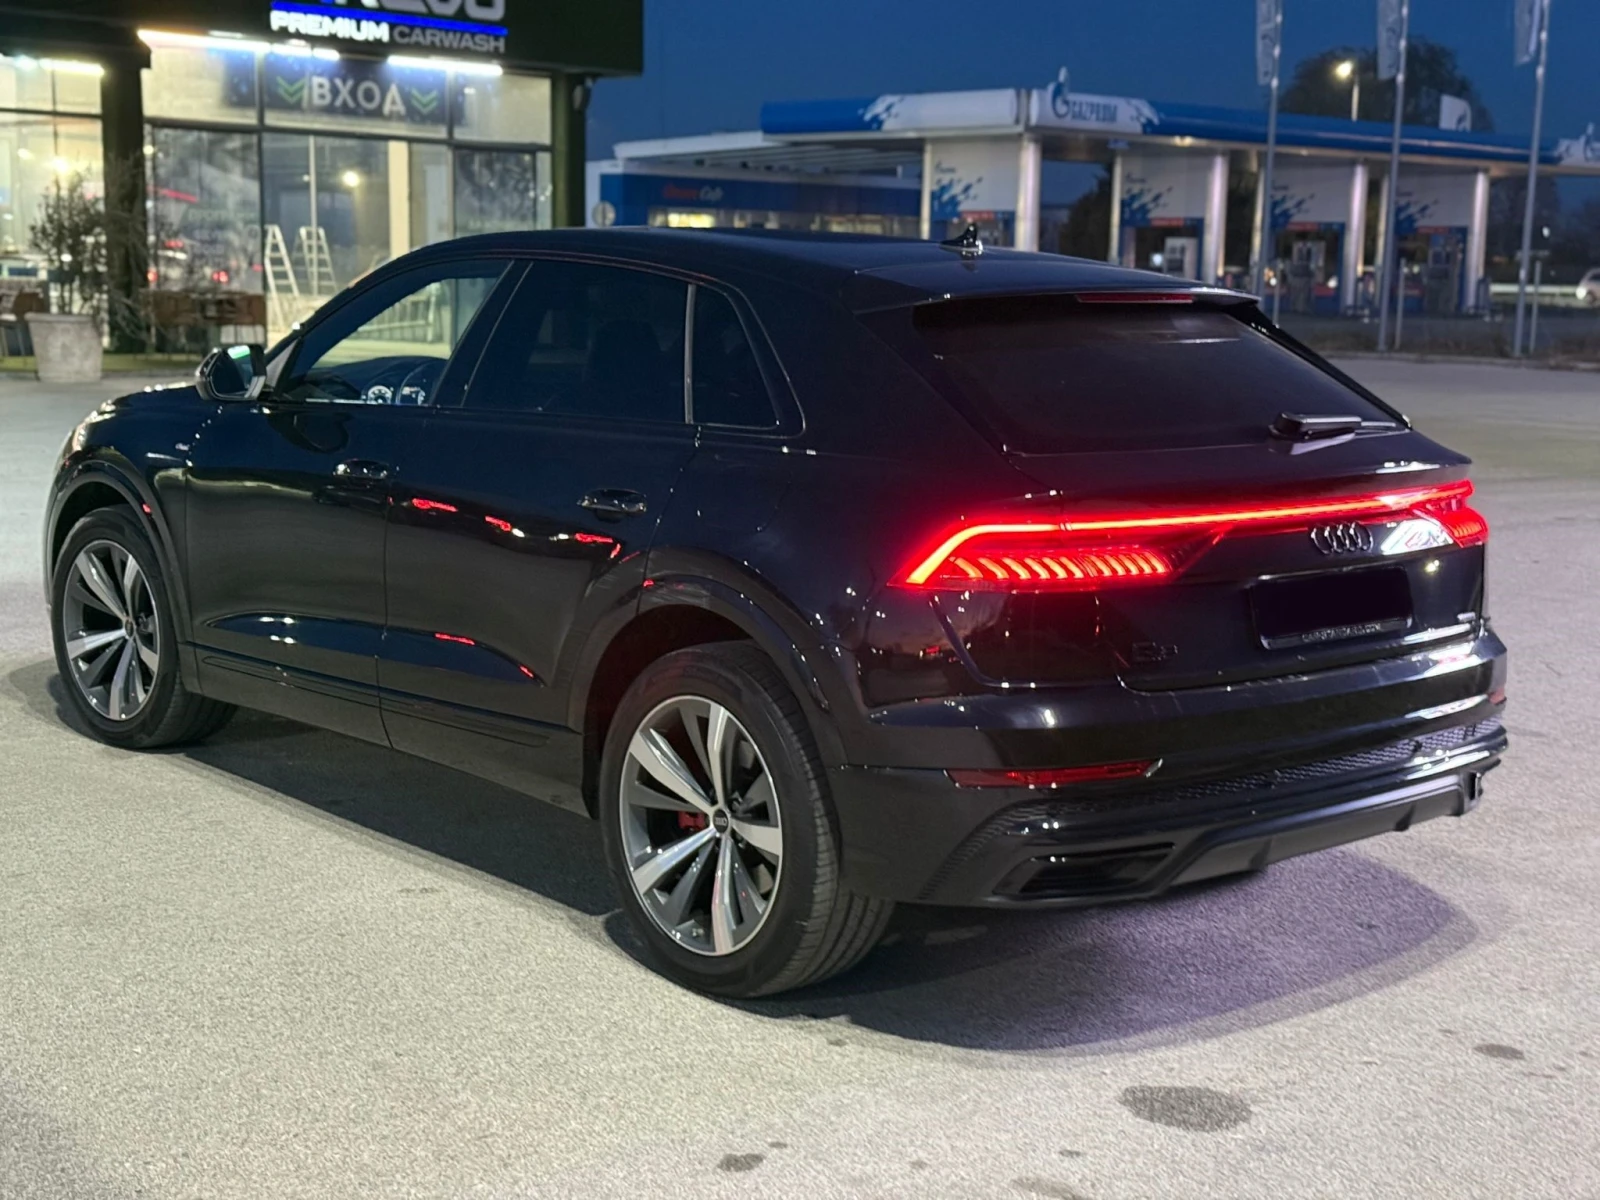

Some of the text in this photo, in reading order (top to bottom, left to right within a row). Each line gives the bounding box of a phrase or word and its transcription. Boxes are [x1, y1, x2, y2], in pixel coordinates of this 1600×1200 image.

[270, 11, 506, 53] PREMIUM CARWASH
[312, 76, 406, 116] ВХОД
